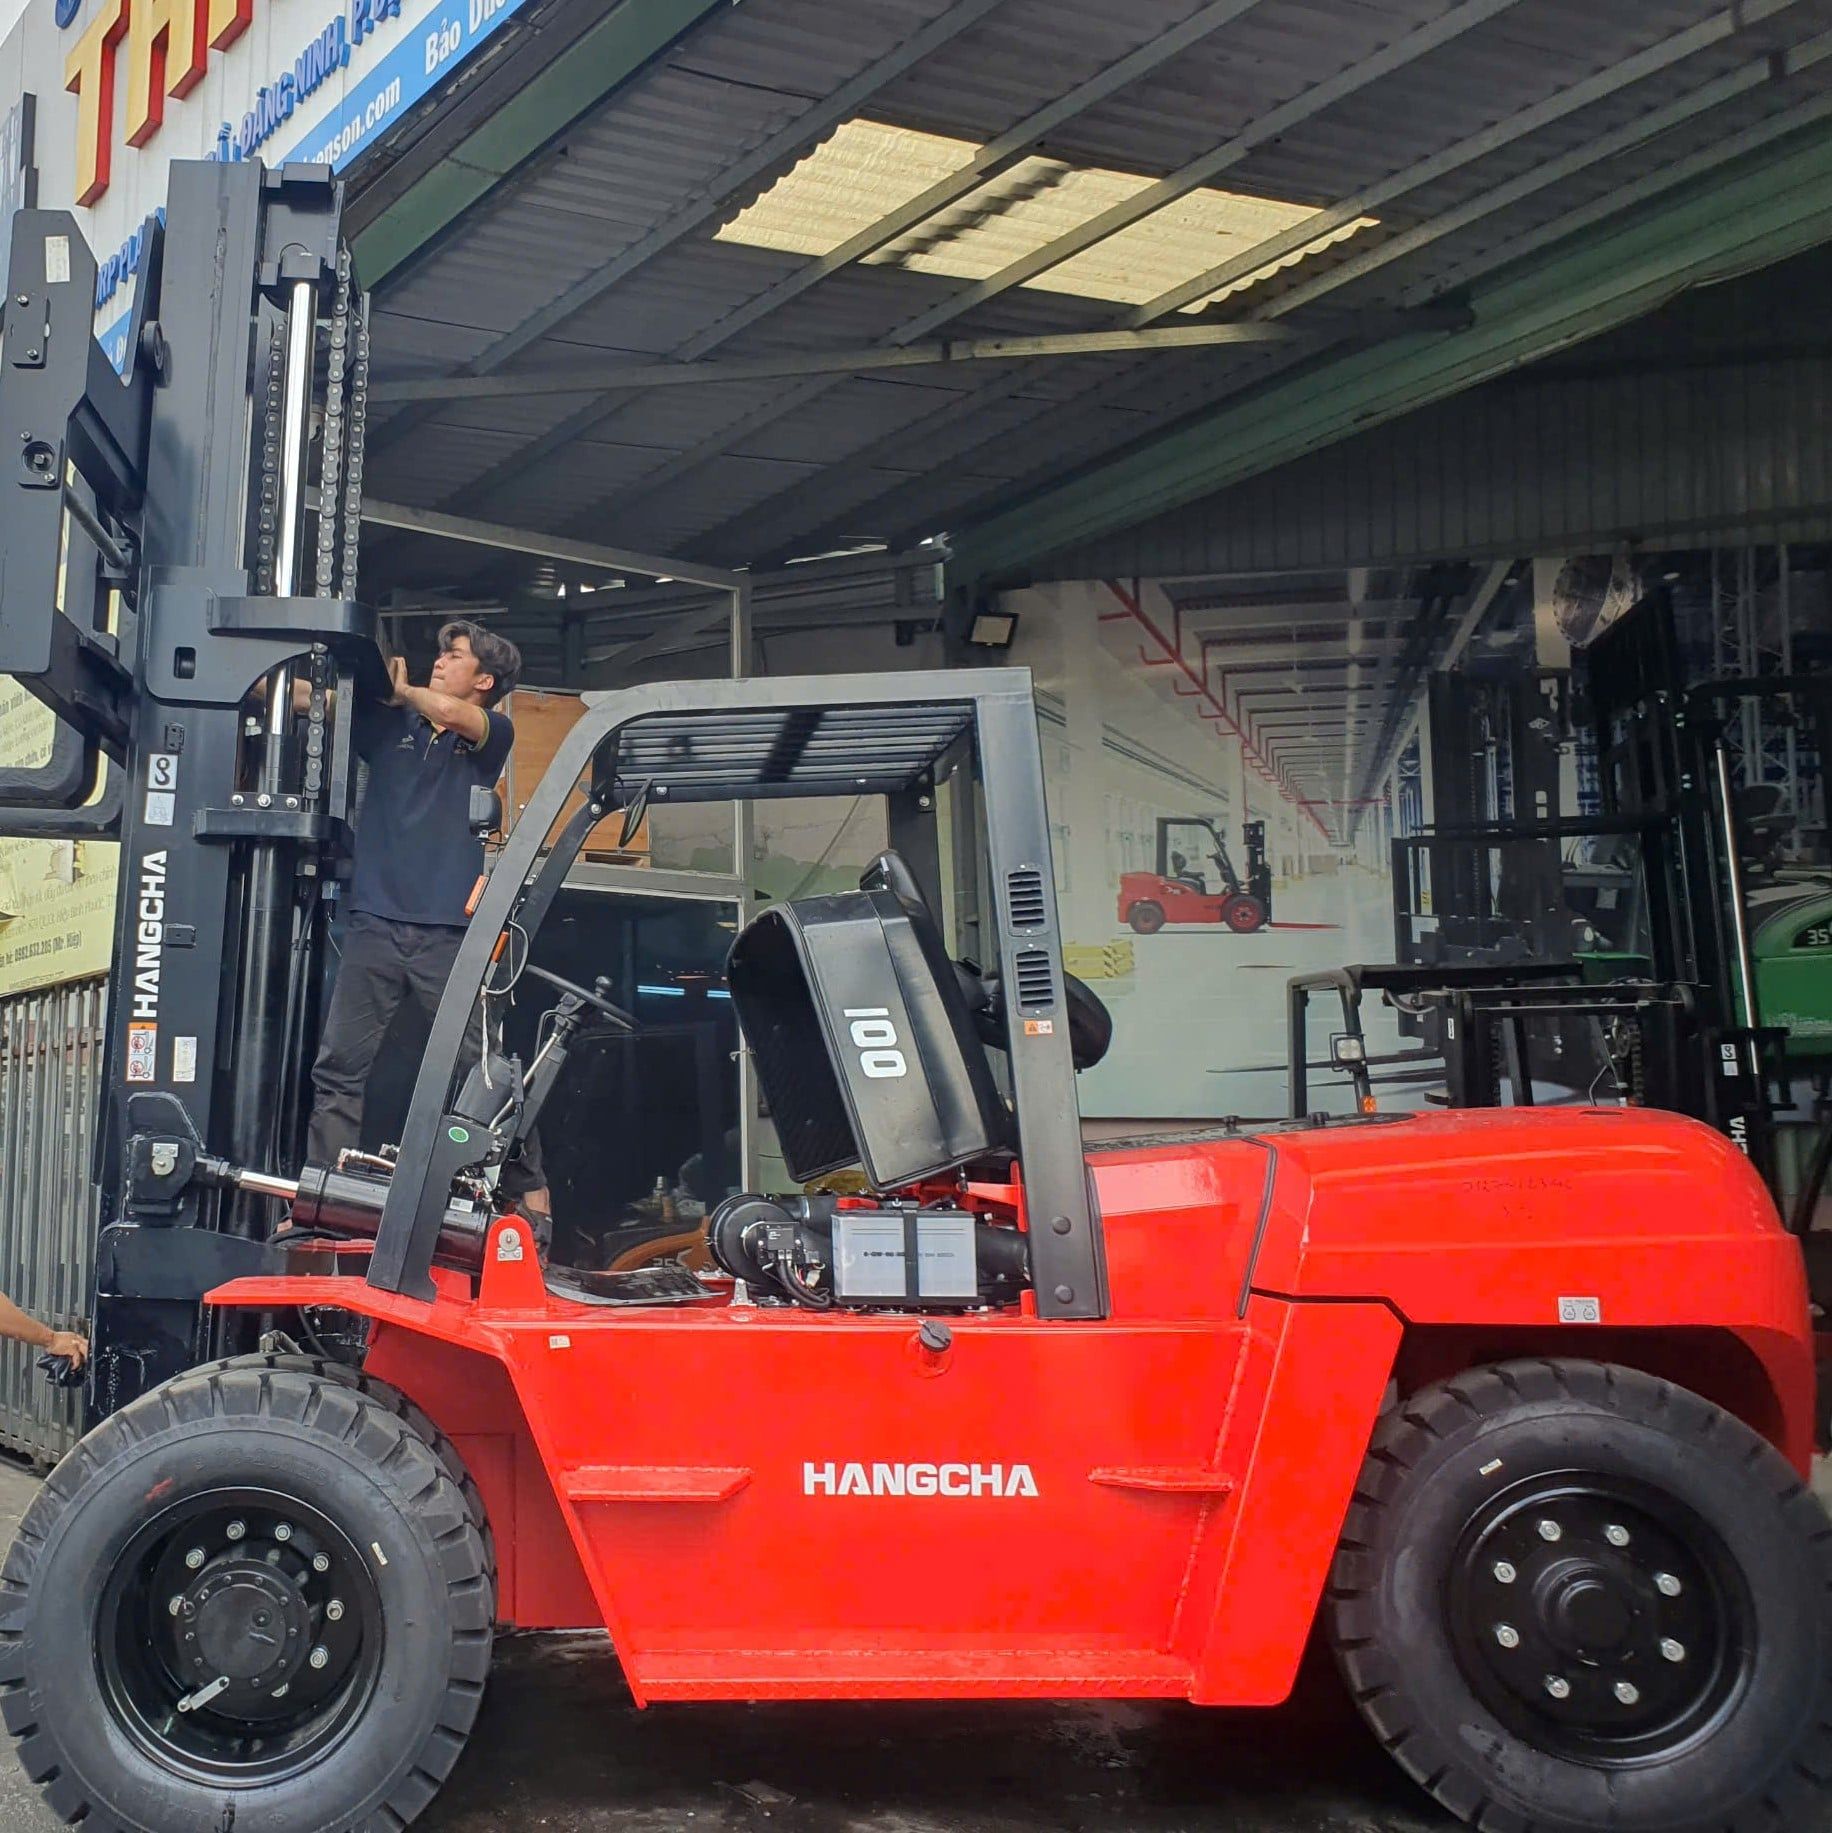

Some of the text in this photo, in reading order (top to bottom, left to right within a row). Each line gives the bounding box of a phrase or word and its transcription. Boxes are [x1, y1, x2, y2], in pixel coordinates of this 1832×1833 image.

[425, 18, 461, 75] Bảo
[133, 850, 167, 1018] HANGCHA
[843, 1008, 907, 1078] 100
[803, 1462, 1039, 1497] HANGCHA
